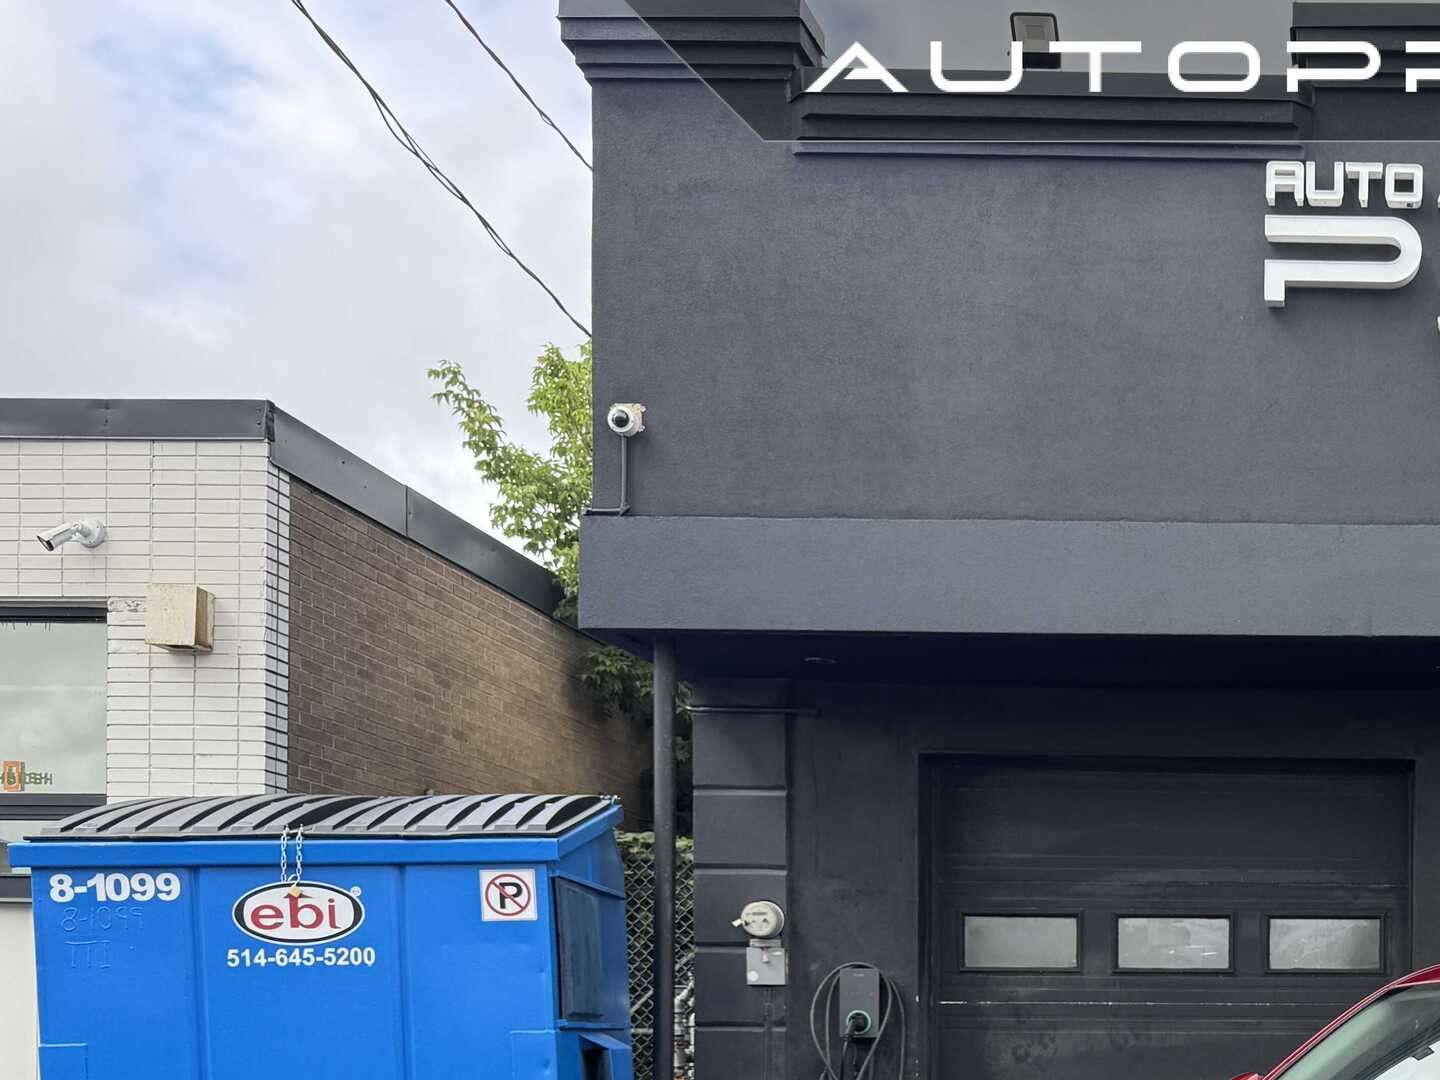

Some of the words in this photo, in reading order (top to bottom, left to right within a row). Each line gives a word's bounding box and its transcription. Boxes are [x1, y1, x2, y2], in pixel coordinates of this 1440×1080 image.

[1265, 160, 1423, 209] AUTO
[50, 873, 181, 902] 8-1099
[250, 892, 342, 930] ebi
[227, 948, 376, 967] 514-645-5200
